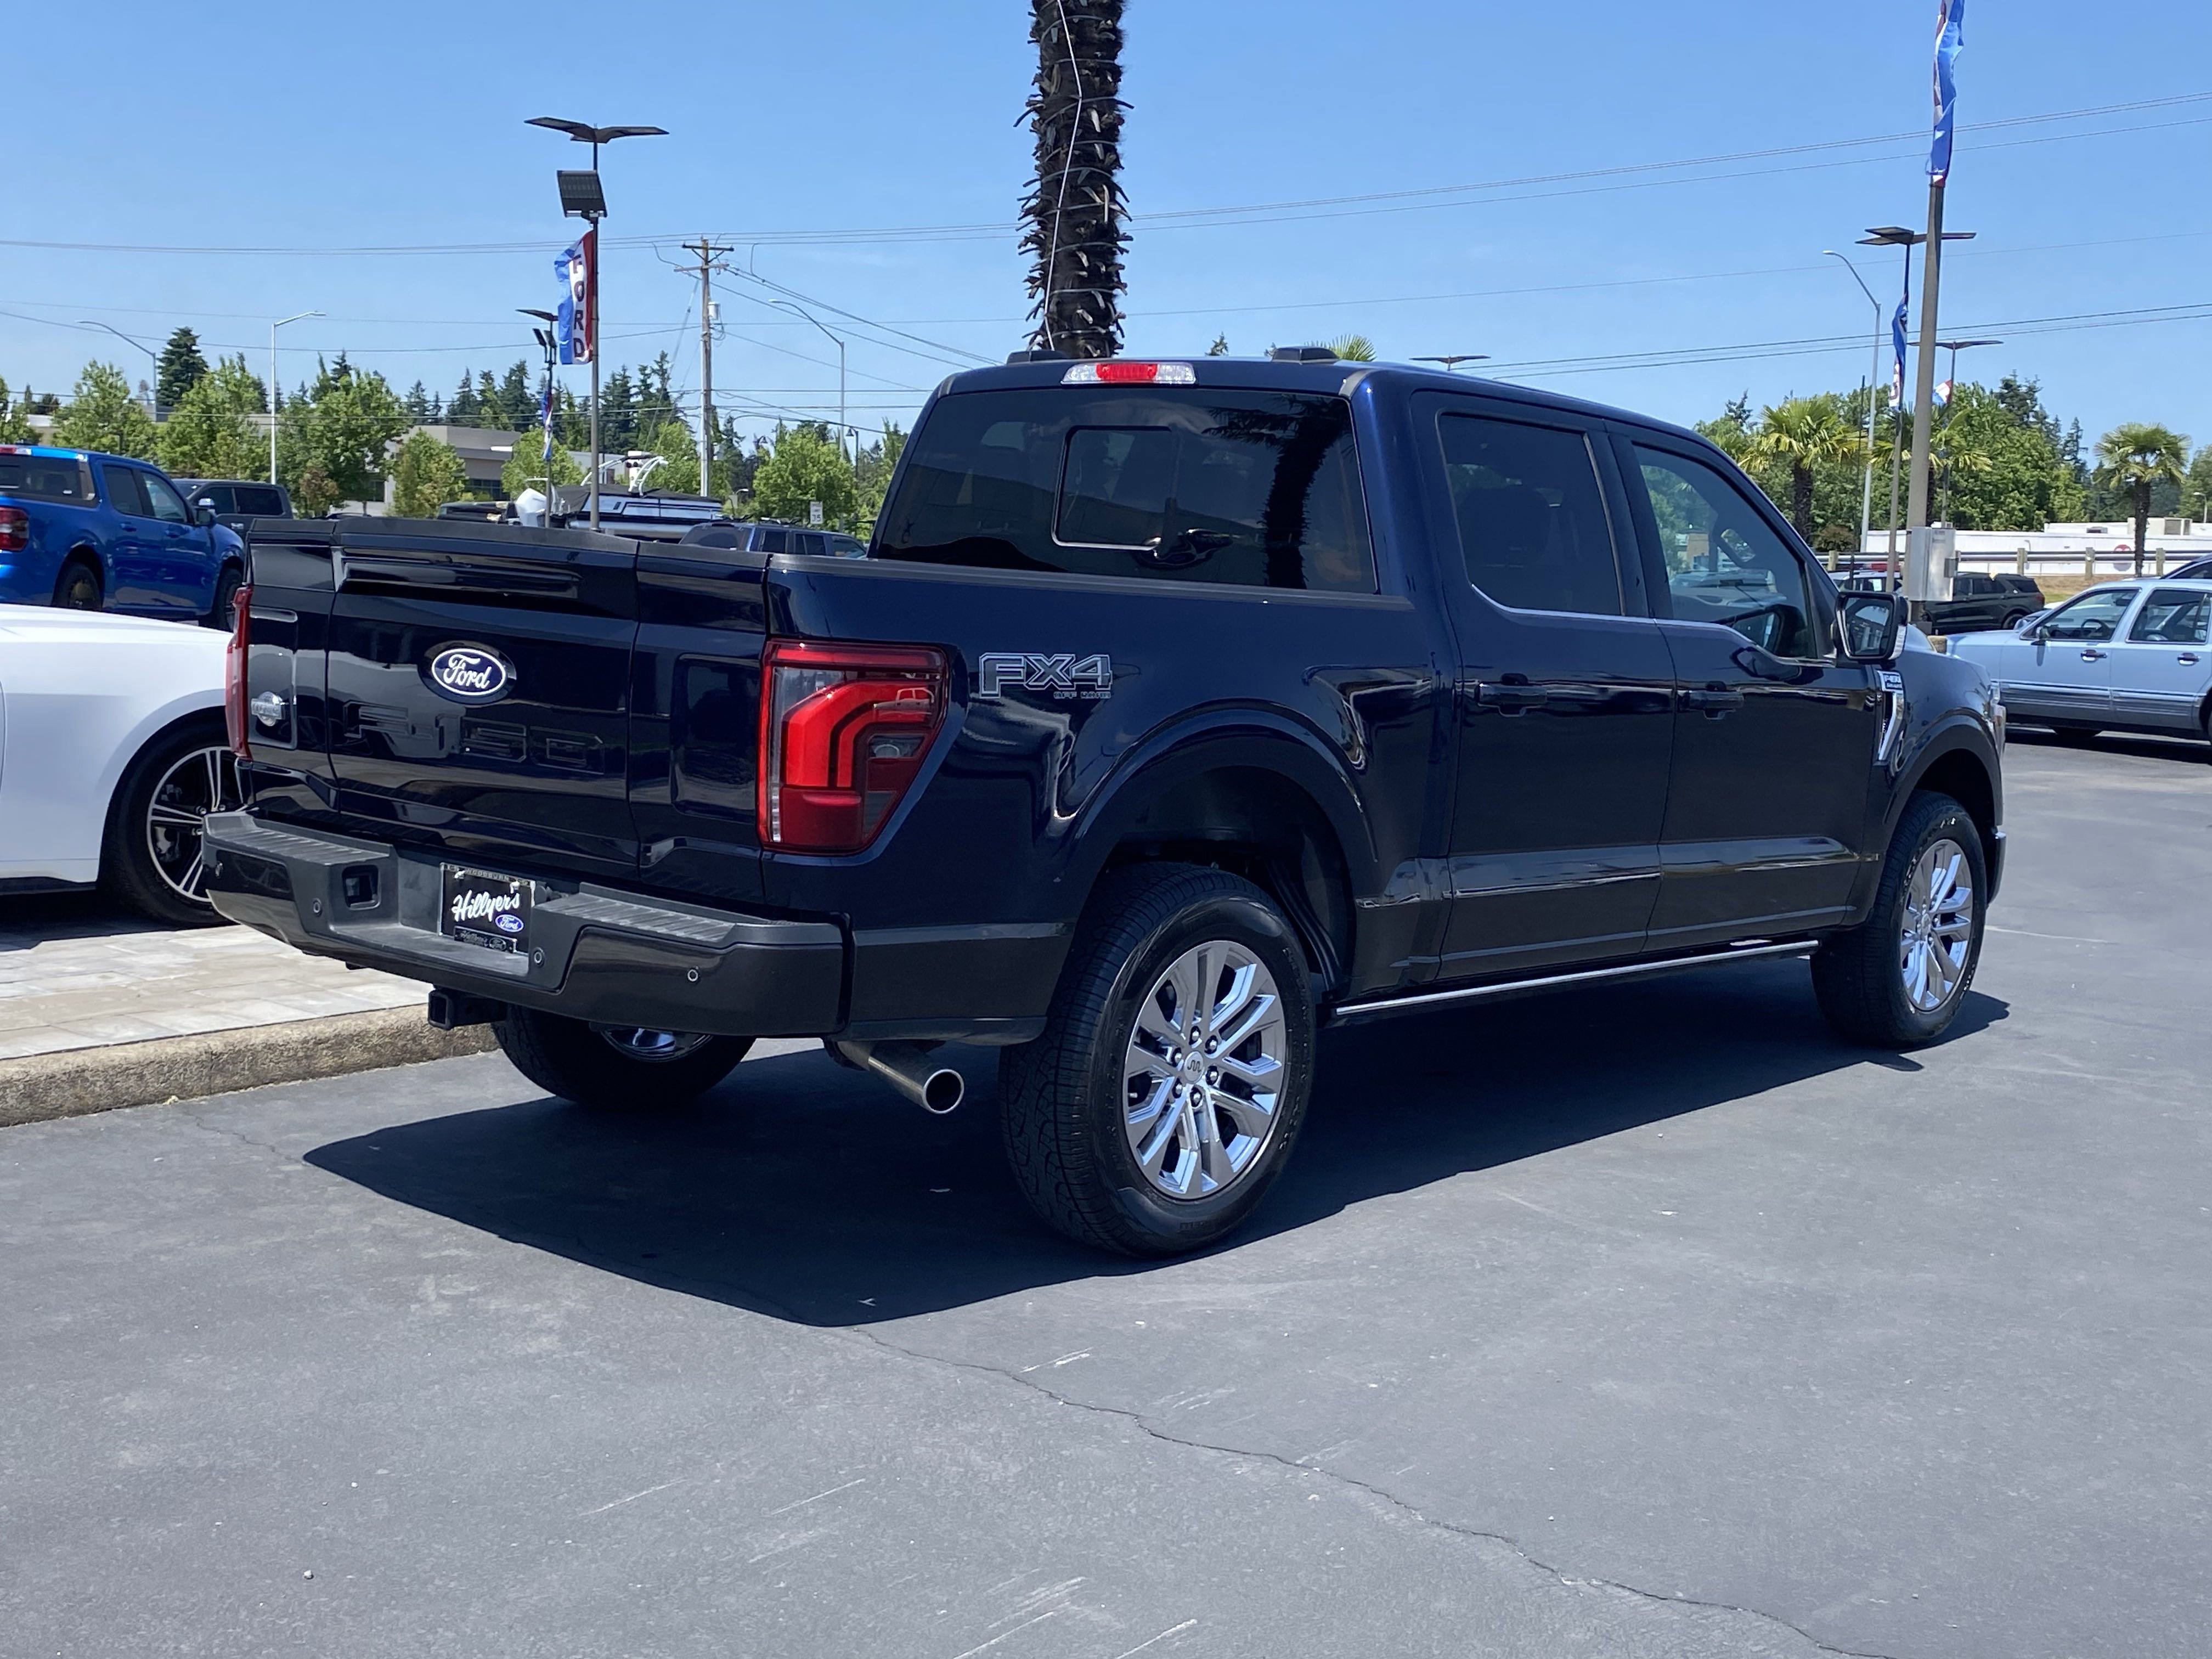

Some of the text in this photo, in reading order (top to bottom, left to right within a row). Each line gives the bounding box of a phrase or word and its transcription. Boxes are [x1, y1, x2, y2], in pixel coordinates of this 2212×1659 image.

[573, 254, 585, 357] FORD
[443, 653, 492, 689] Ford
[979, 652, 1113, 698] FX4
[499, 916, 519, 930] Ford
